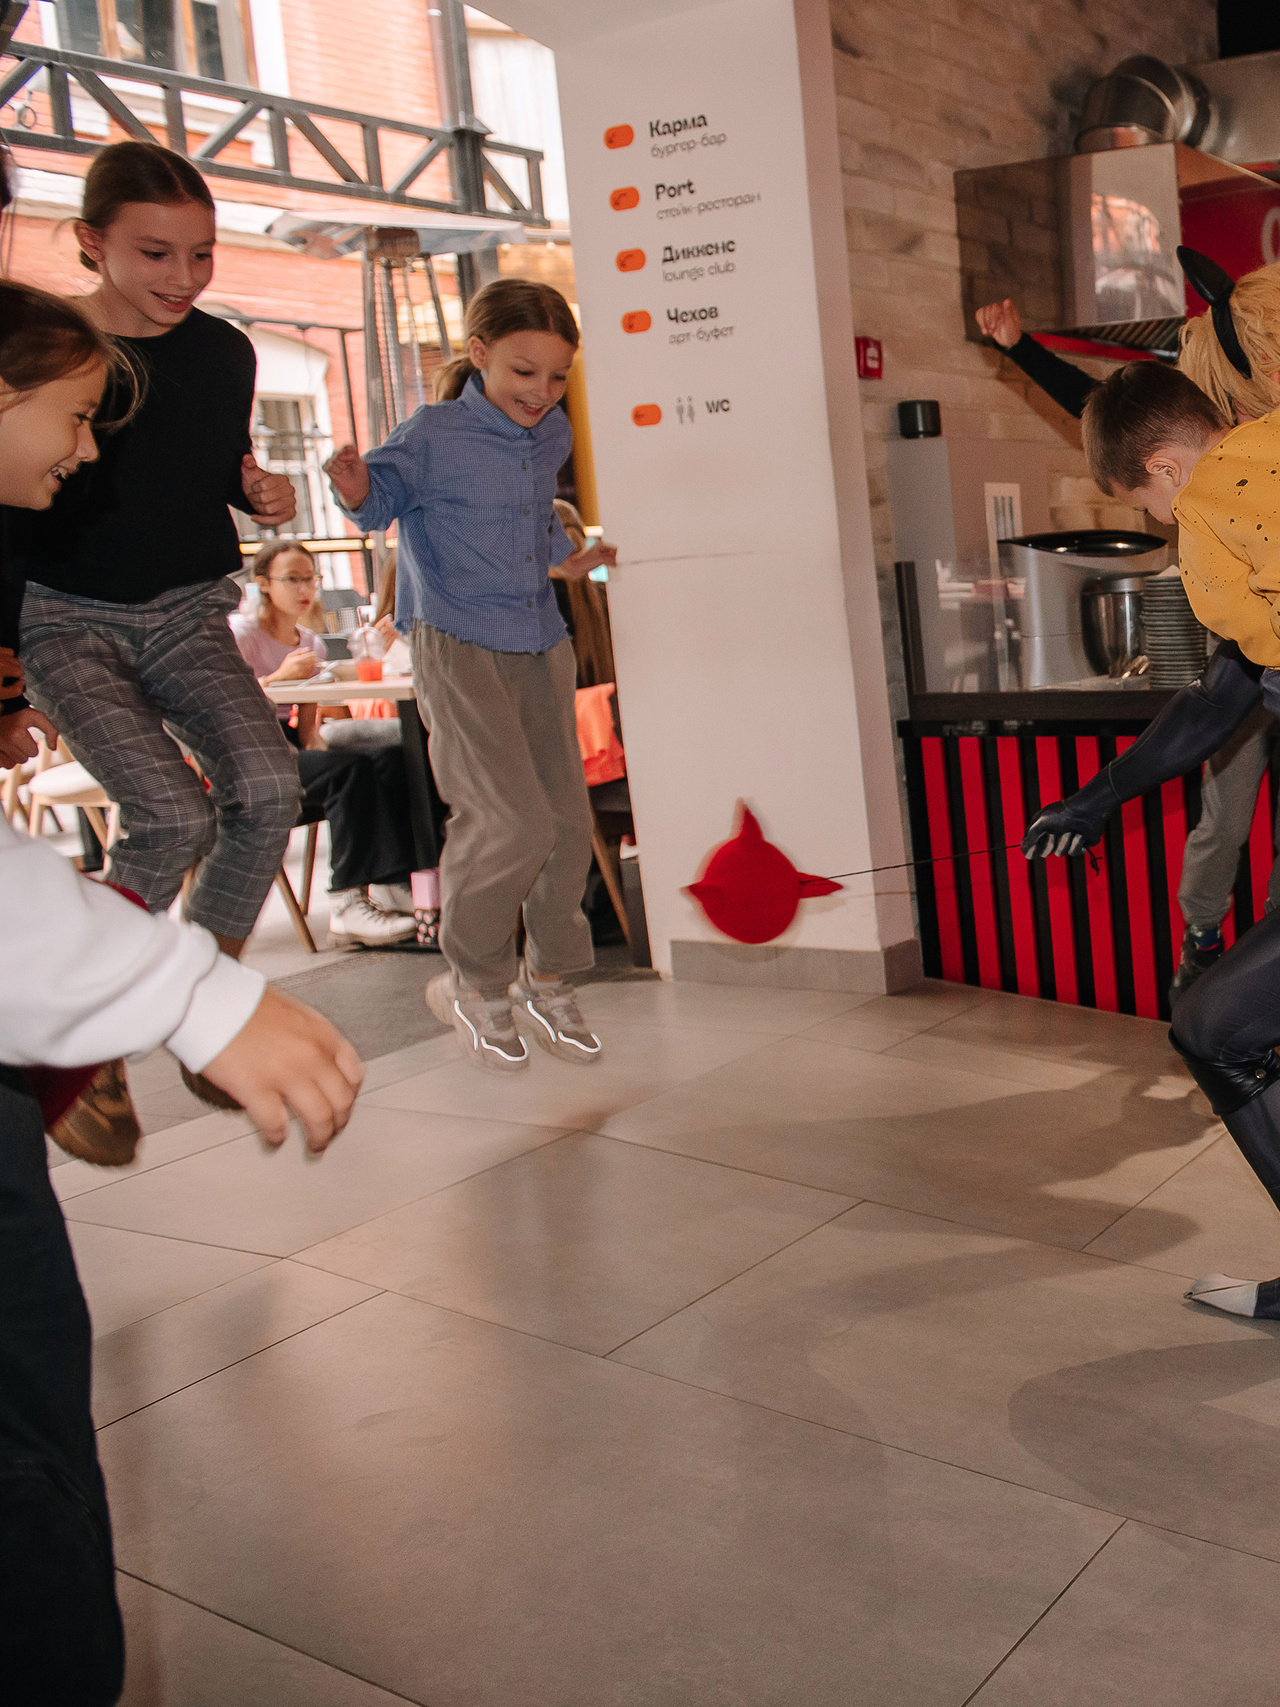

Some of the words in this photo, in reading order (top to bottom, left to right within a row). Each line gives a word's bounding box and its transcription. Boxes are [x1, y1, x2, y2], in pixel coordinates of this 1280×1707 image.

[649, 114, 708, 138] Карма
[655, 179, 695, 201] Port
[661, 239, 736, 263] Диккенс
[662, 266, 705, 282] lounge
[666, 306, 719, 323] Чехов
[705, 397, 731, 414] WC
